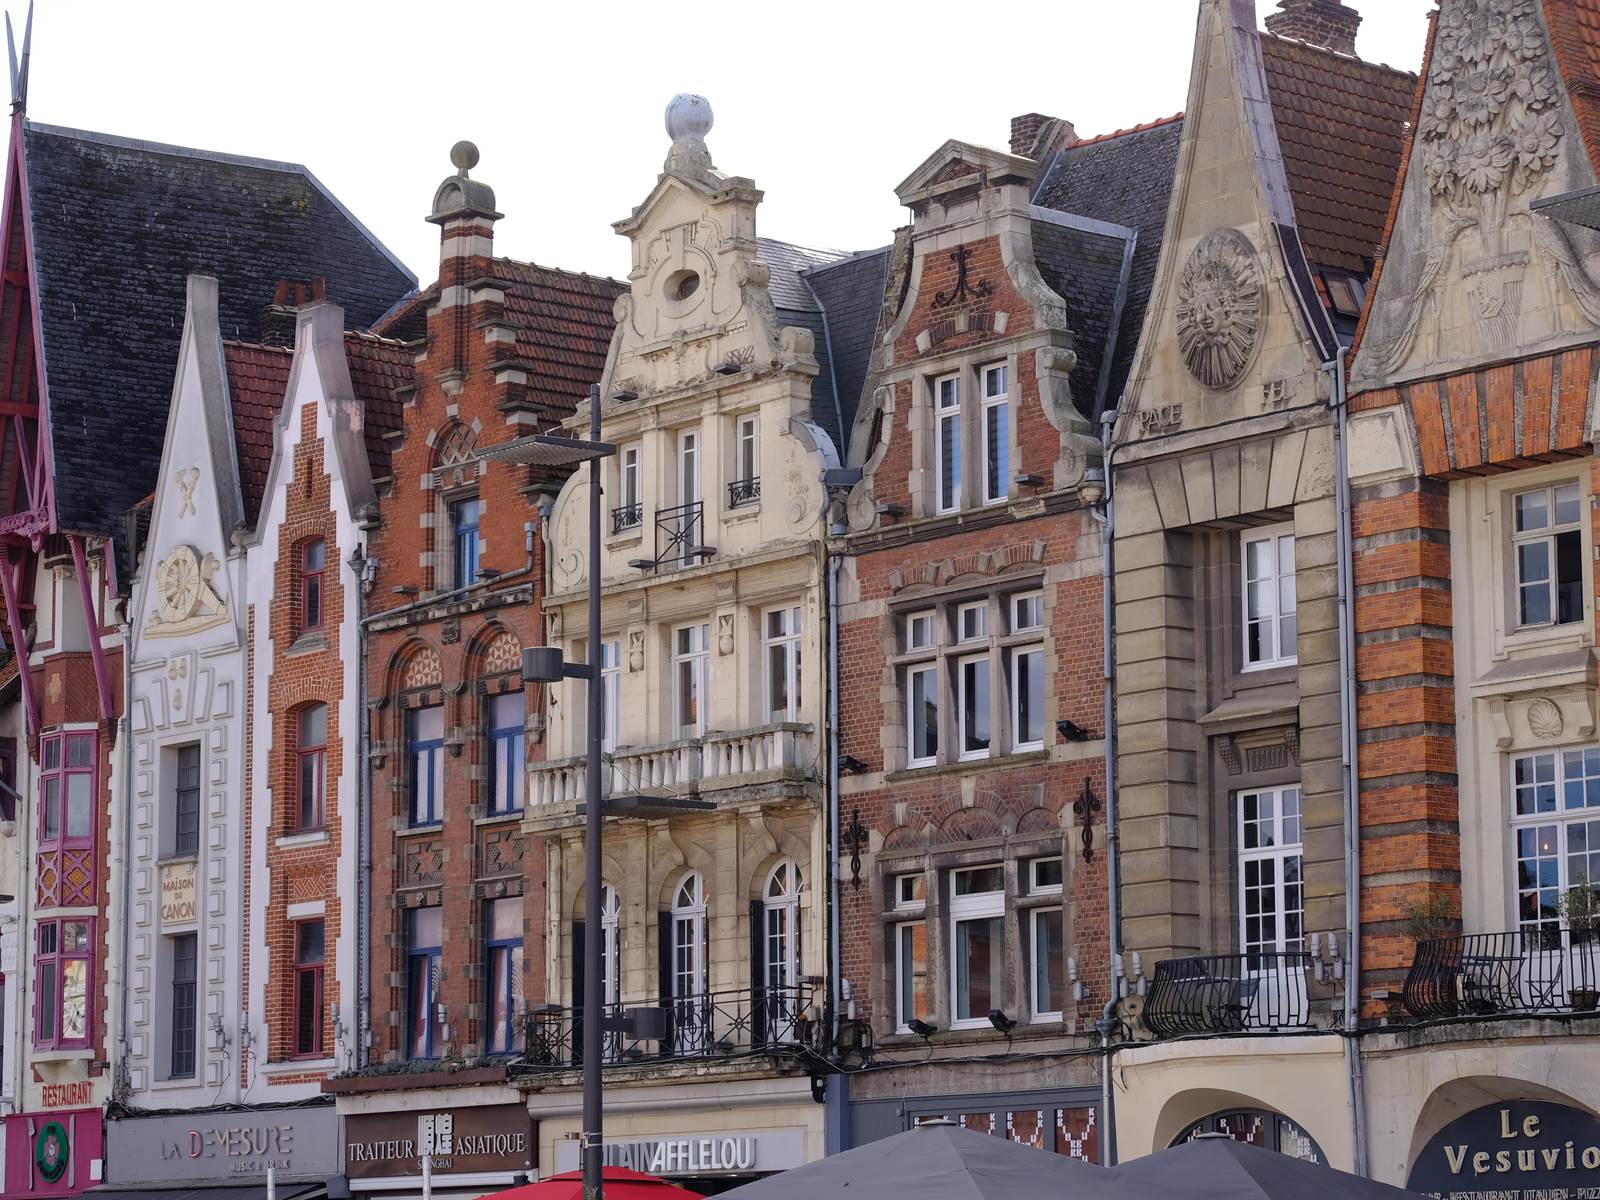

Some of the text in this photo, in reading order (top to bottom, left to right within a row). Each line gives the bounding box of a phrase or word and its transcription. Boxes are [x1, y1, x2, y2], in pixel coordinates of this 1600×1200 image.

[1138, 404, 1182, 431] PACE
[161, 901, 195, 920] CANON
[42, 1081, 93, 1107] RESTAURANT
[1500, 1109, 1540, 1138] Le
[348, 1133, 526, 1161] TRAITEUR ASIATIQUE
[650, 1137, 757, 1172] AFFLELOU
[1443, 1140, 1600, 1175] Vesuvio
[229, 1161, 254, 1173] MUSIC
[417, 1157, 453, 1170] SNGHAI
